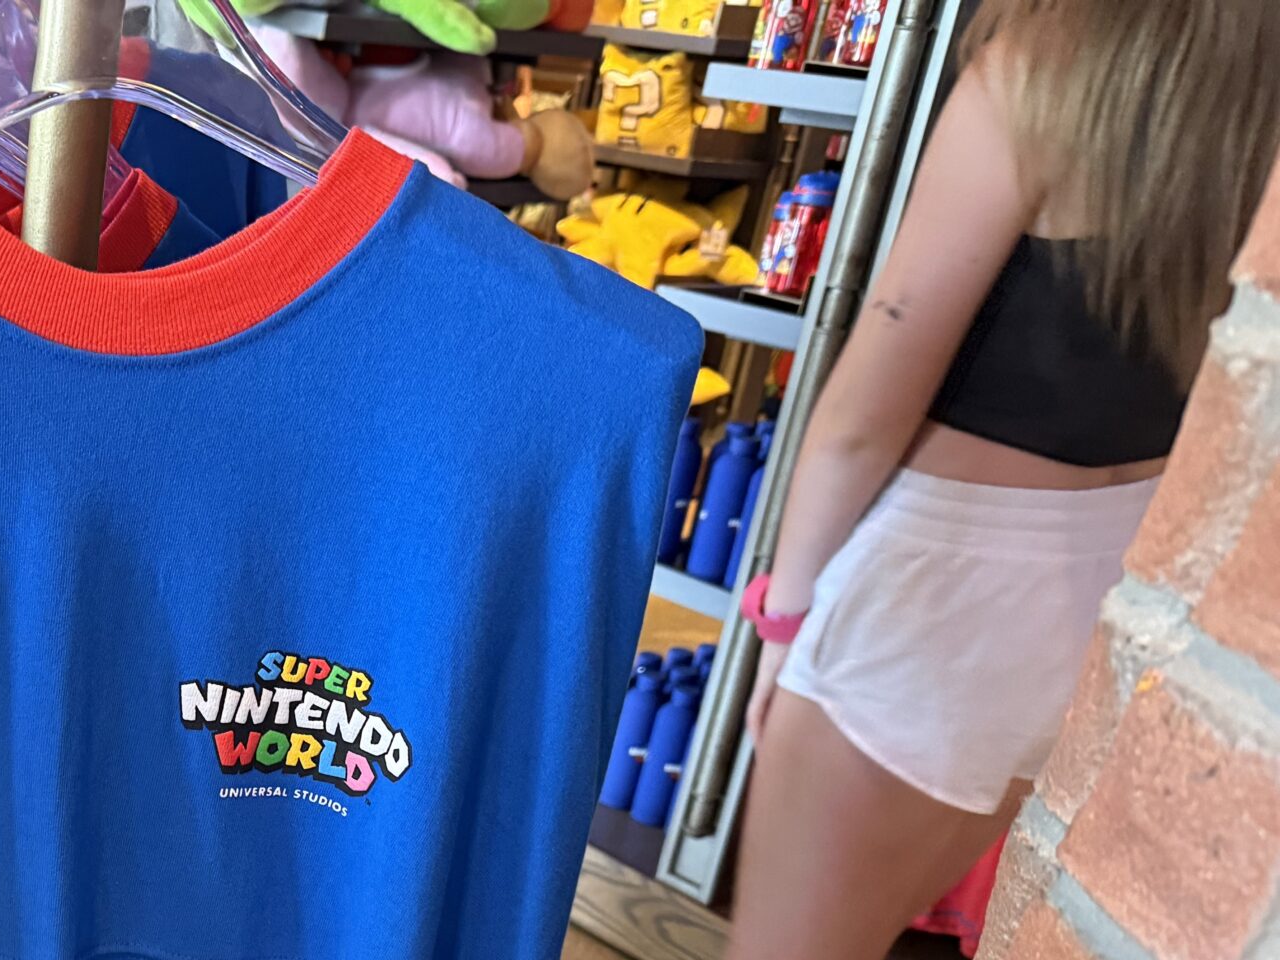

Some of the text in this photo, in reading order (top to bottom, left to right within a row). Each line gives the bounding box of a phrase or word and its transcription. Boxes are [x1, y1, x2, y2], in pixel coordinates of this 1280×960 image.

[257, 651, 372, 702] SUPER
[180, 682, 410, 778] NINTENDO
[214, 730, 376, 792] WORLD
[219, 786, 348, 817] UNIVERSAL STUDIOS
